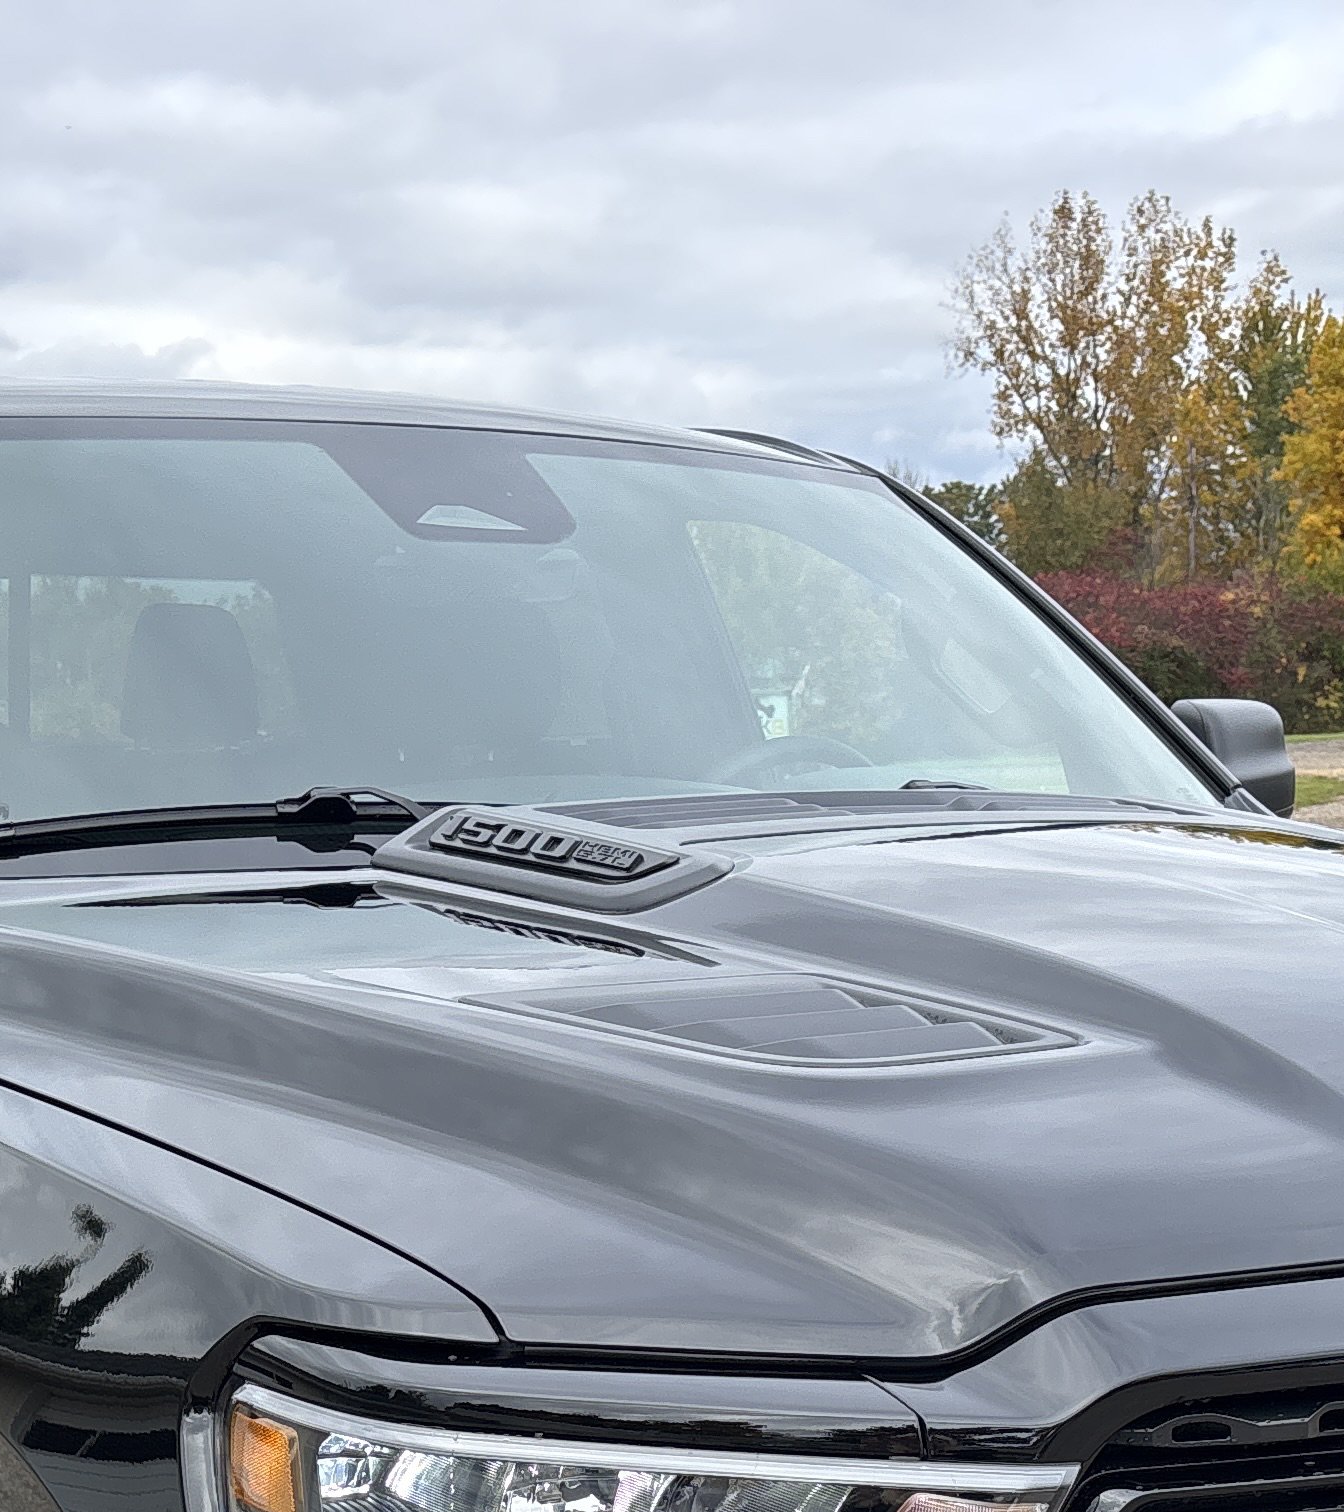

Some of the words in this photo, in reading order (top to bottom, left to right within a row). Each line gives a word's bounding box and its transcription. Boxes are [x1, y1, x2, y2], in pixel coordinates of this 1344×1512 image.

[440, 814, 580, 862] 1500
[576, 849, 626, 866] 5.7L
[581, 840, 638, 859] HEMI
